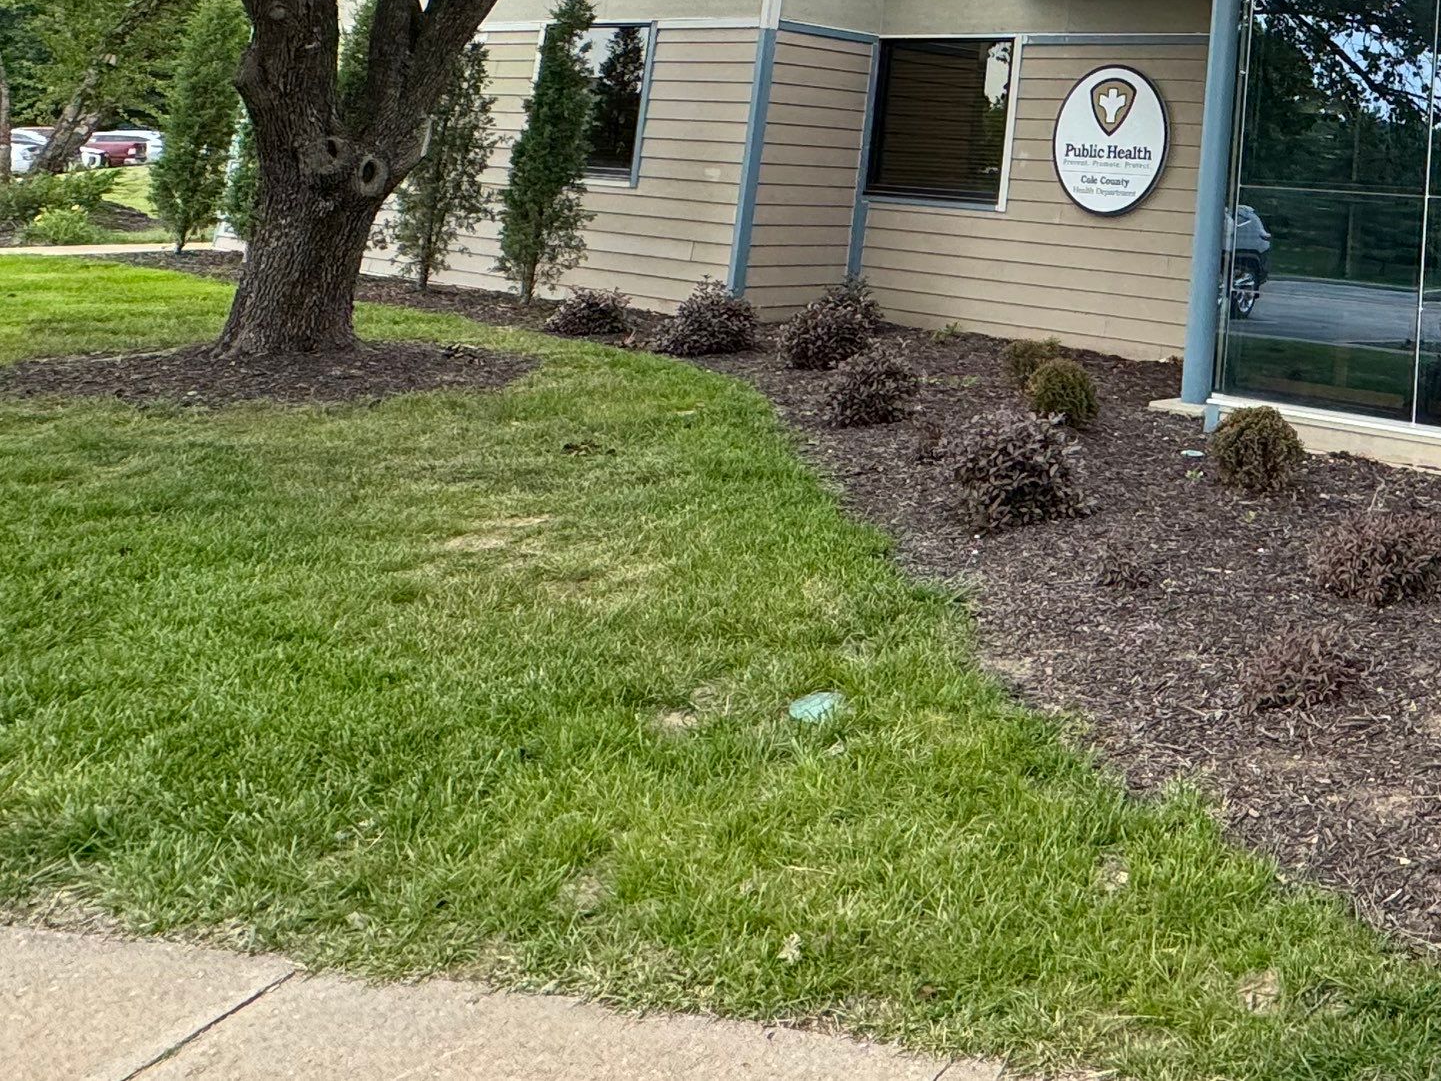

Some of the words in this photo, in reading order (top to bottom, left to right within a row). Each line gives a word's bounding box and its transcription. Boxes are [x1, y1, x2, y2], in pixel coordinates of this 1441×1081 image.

[1065, 143, 1105, 158] Public
[1106, 145, 1152, 160] Health
[1100, 176, 1130, 188] County
[1073, 186, 1094, 195] Health
[1095, 187, 1136, 196] Department
